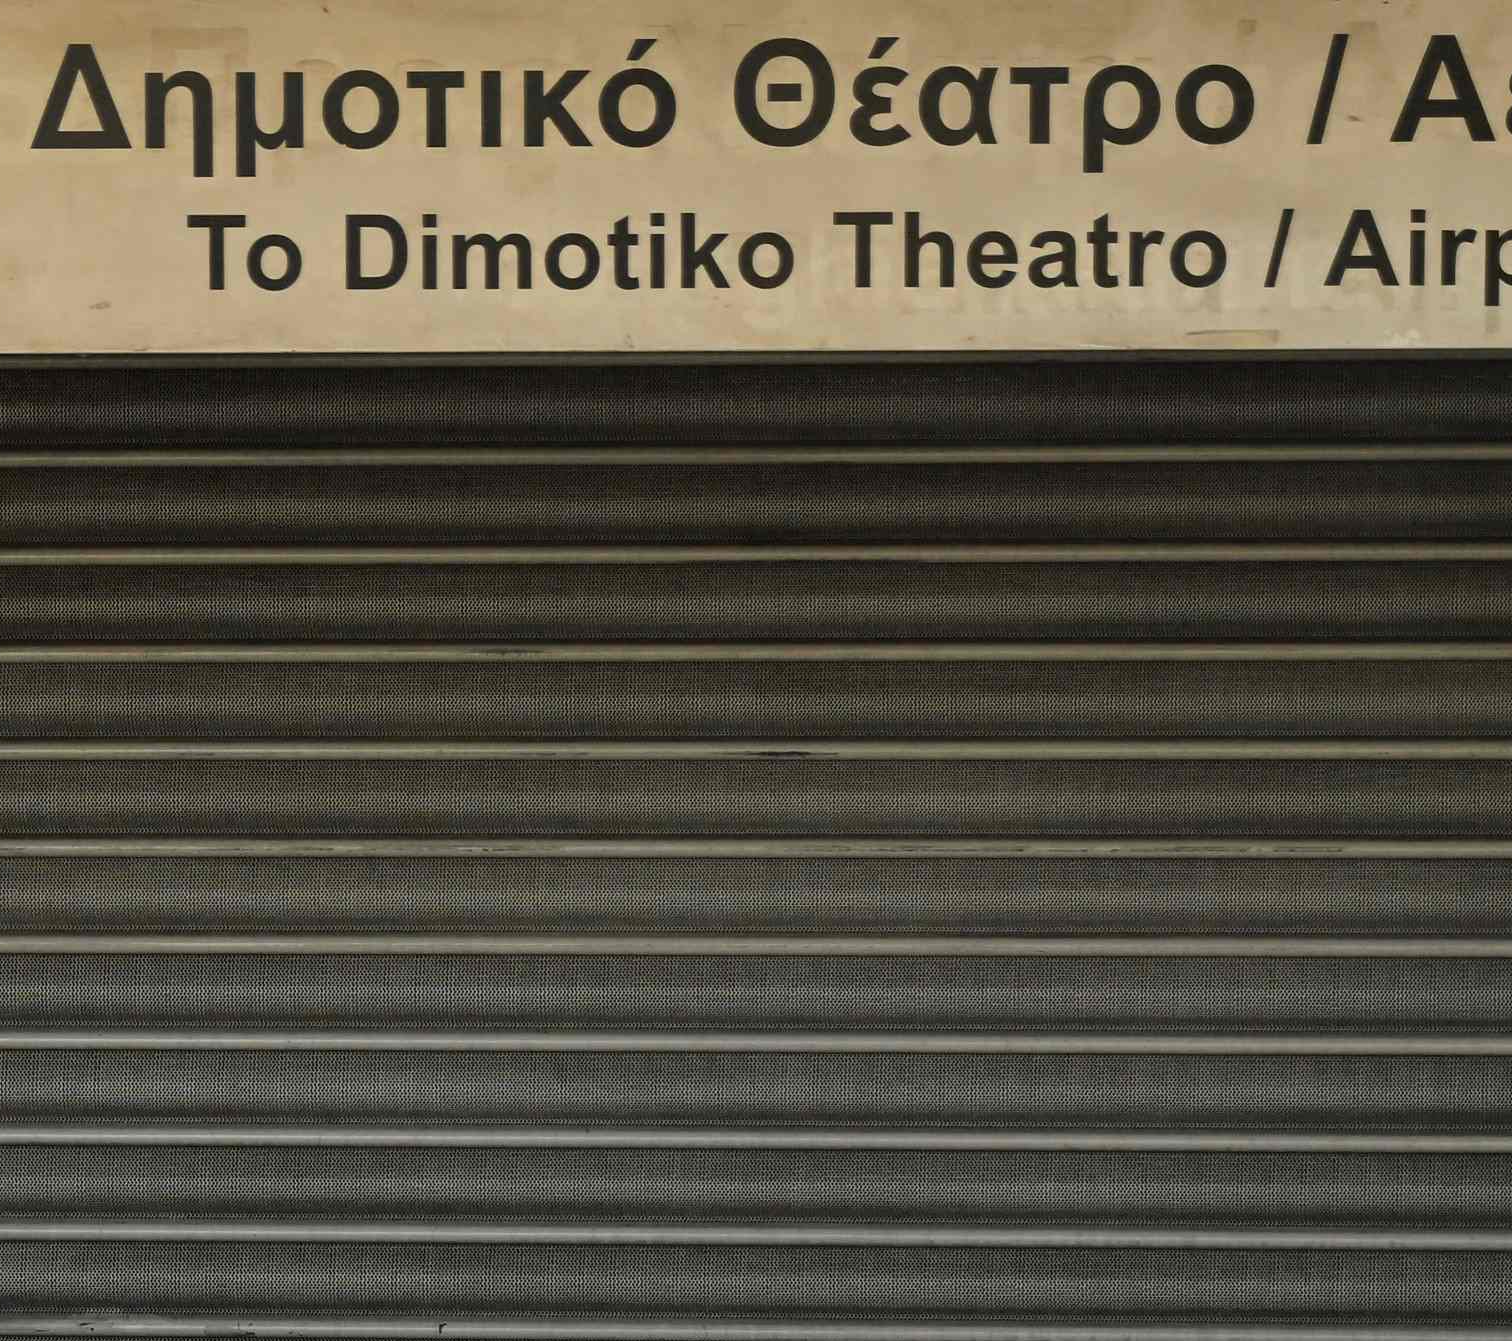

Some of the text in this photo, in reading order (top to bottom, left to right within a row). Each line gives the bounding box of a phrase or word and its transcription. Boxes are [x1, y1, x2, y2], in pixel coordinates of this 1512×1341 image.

[30, 38, 678, 178] Δημοτικό
[733, 36, 1255, 174] Θέατρο
[1306, 33, 1351, 145] /
[186, 214, 303, 292] To
[345, 212, 795, 290] Dimotiko
[832, 211, 1227, 289] Theatro
[1263, 207, 1296, 288] /
